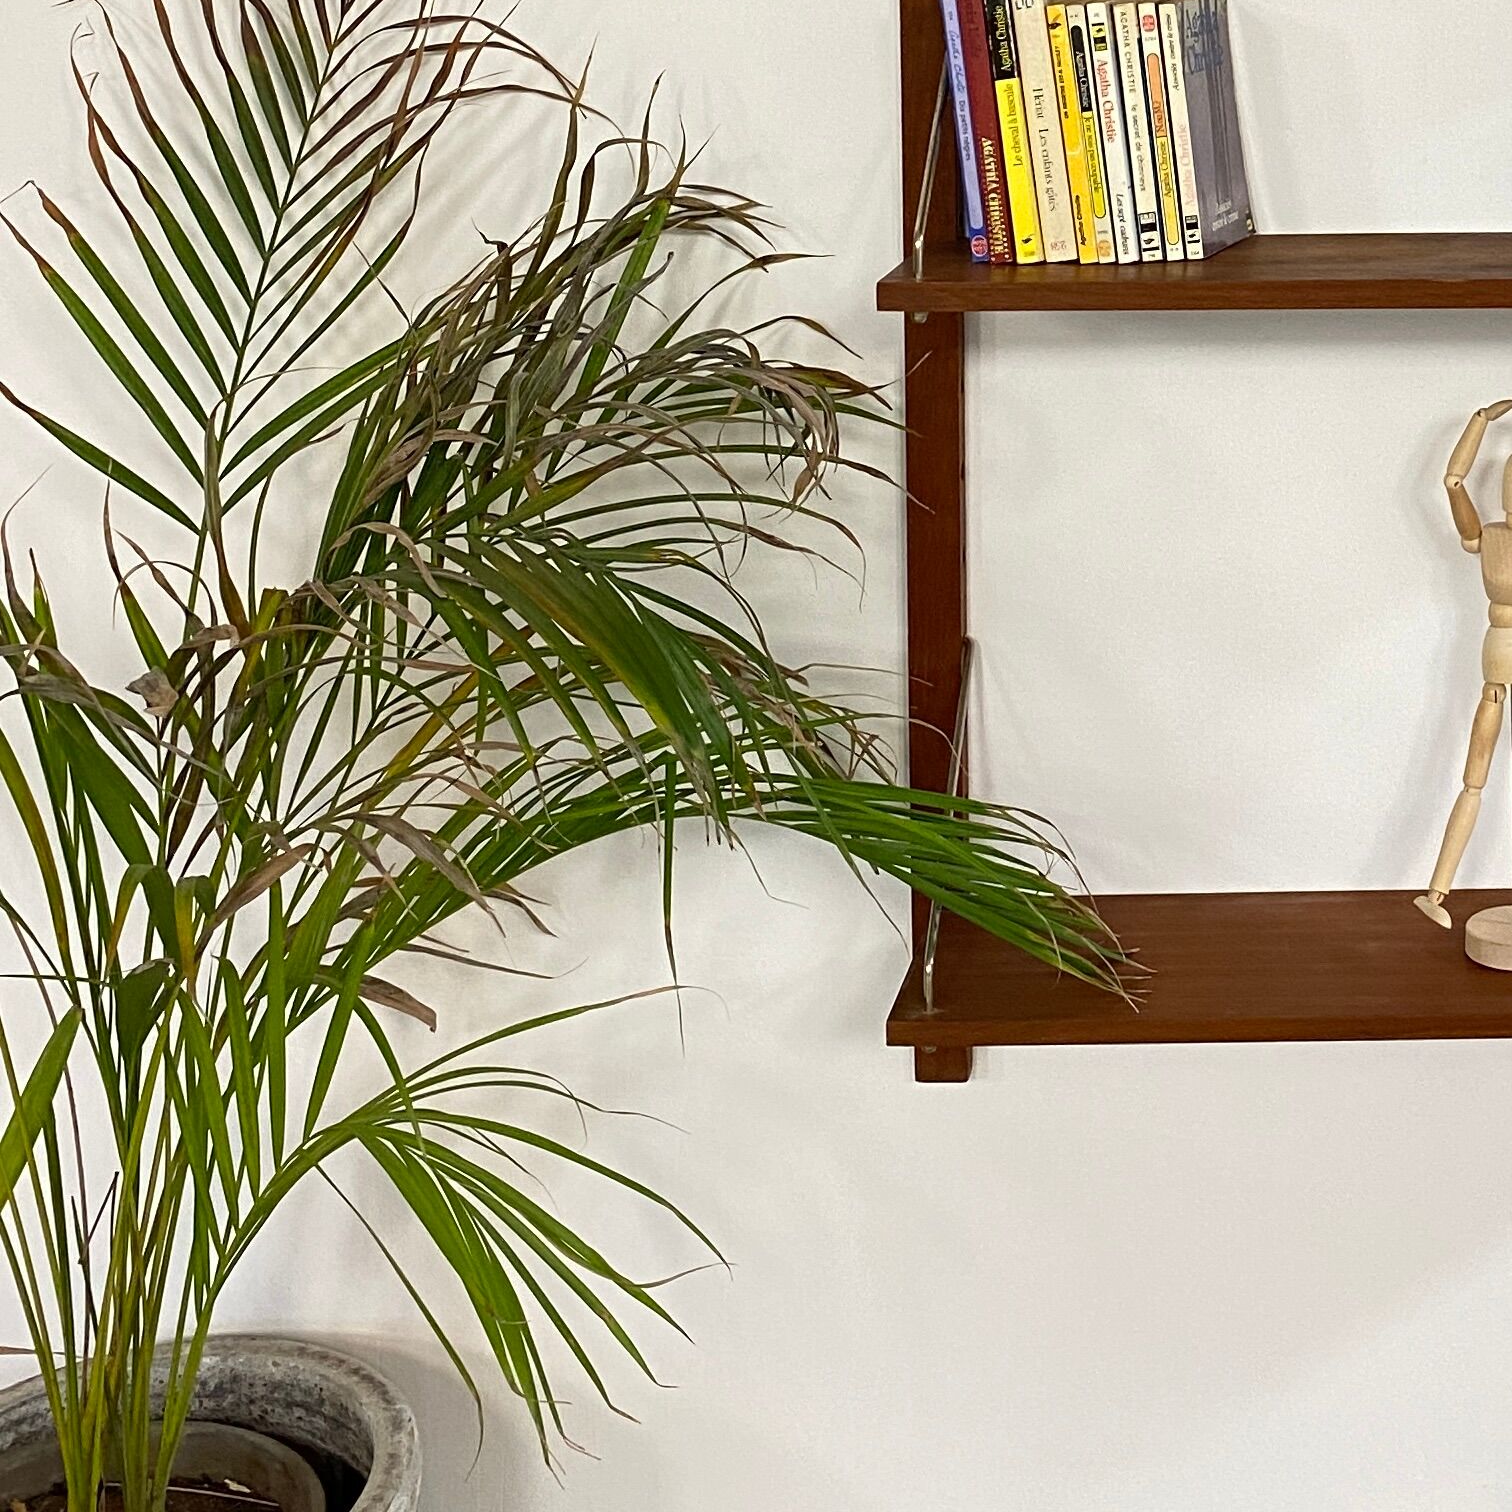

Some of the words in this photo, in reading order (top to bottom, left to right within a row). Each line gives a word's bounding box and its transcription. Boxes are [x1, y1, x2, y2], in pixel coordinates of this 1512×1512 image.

[992, 5, 1007, 40] Christie
[1119, 11, 1131, 48] AGATHA
[997, 41, 1012, 72] Agatha
[1124, 51, 1137, 93] CHRISTIE
[1095, 59, 1112, 97] Agatha
[1003, 83, 1017, 117] bascule
[1039, 128, 1051, 147] Les
[1102, 100, 1118, 143] Christie
[1132, 114, 1142, 139] secret
[1009, 126, 1021, 154] cheval
[1135, 142, 1144, 152] de
[1176, 124, 1191, 167] Christie
[981, 137, 999, 190] AGATHA
[1012, 154, 1023, 166] Le
[1041, 148, 1055, 185] enfants
[1116, 193, 1125, 206] Les
[1161, 172, 1174, 198] Agatha
[1182, 169, 1196, 205] Agatha
[988, 193, 1006, 254] CHRISTIE
[1116, 208, 1127, 223] sept
[1120, 225, 1131, 255] cadrans
